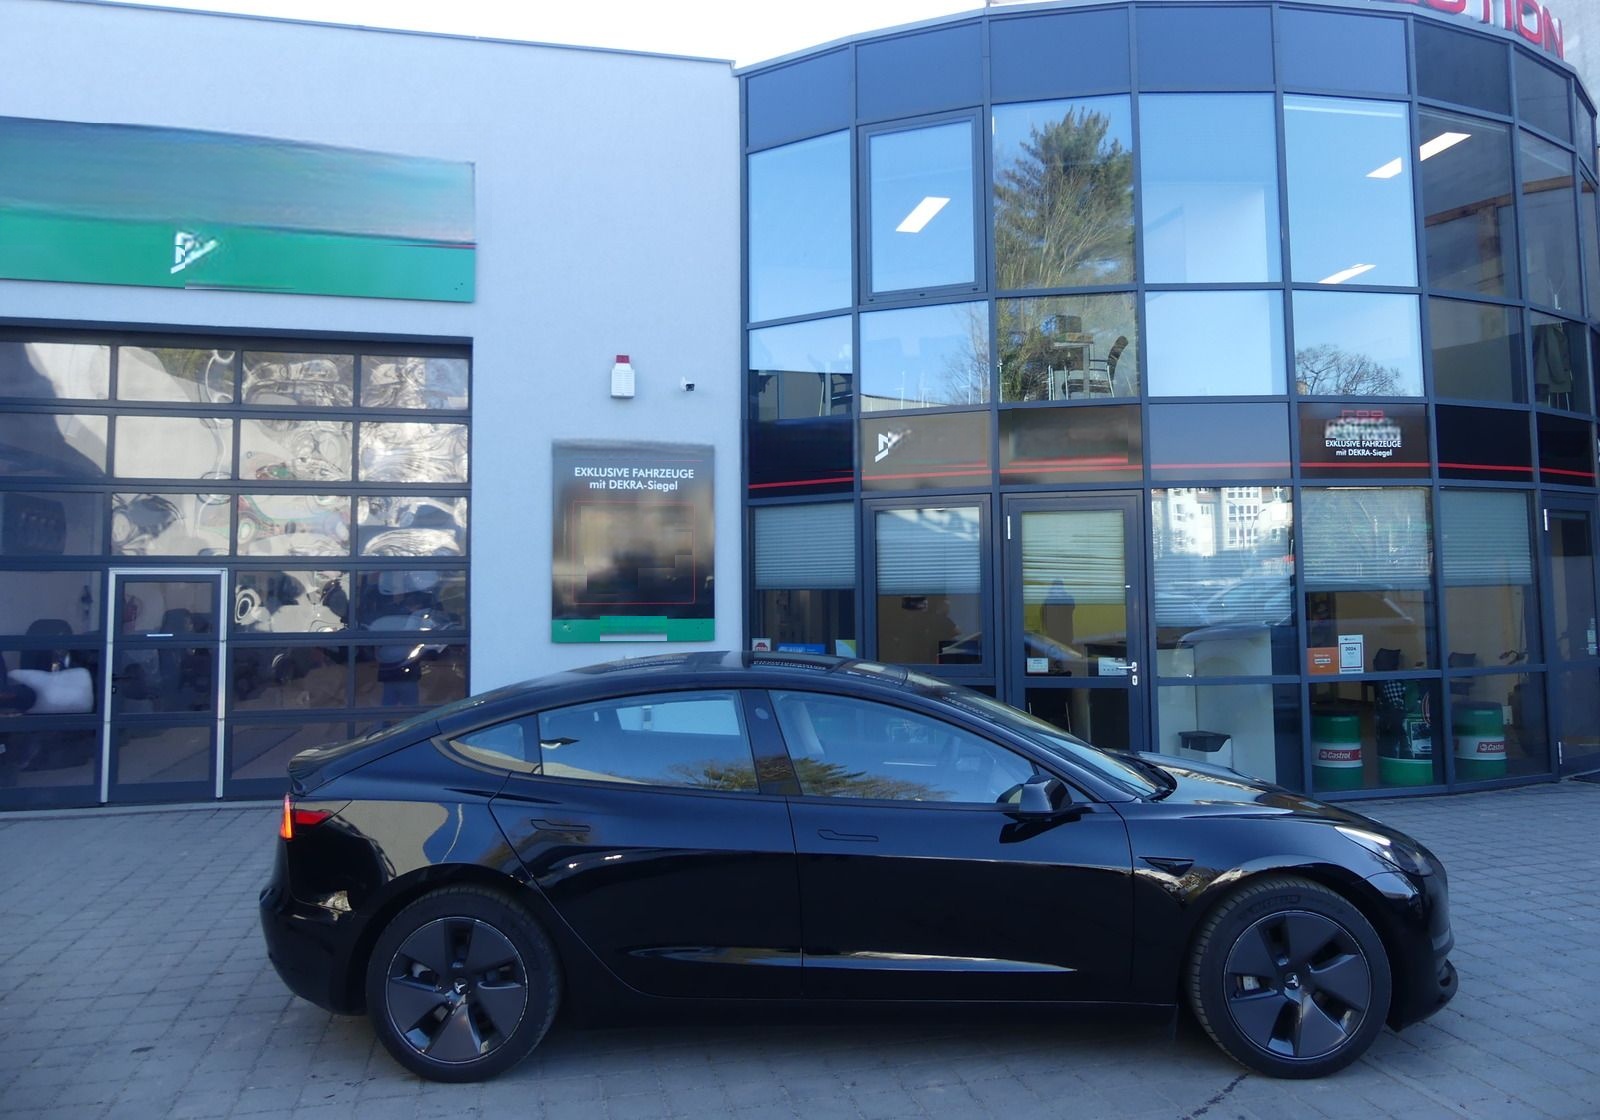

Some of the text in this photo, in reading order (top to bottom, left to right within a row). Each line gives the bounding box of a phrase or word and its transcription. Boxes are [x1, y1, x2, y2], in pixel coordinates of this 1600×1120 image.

[1325, 440, 1402, 448] EXKLUSIVE FAHRZEUGE
[1348, 449, 1393, 458] DEKRA-Siegel
[574, 467, 695, 479] EXKLUSIVE FAHRZEUGE
[589, 480, 678, 493] mit DEKRA-Siegel
[1327, 751, 1351, 760] Castrol
